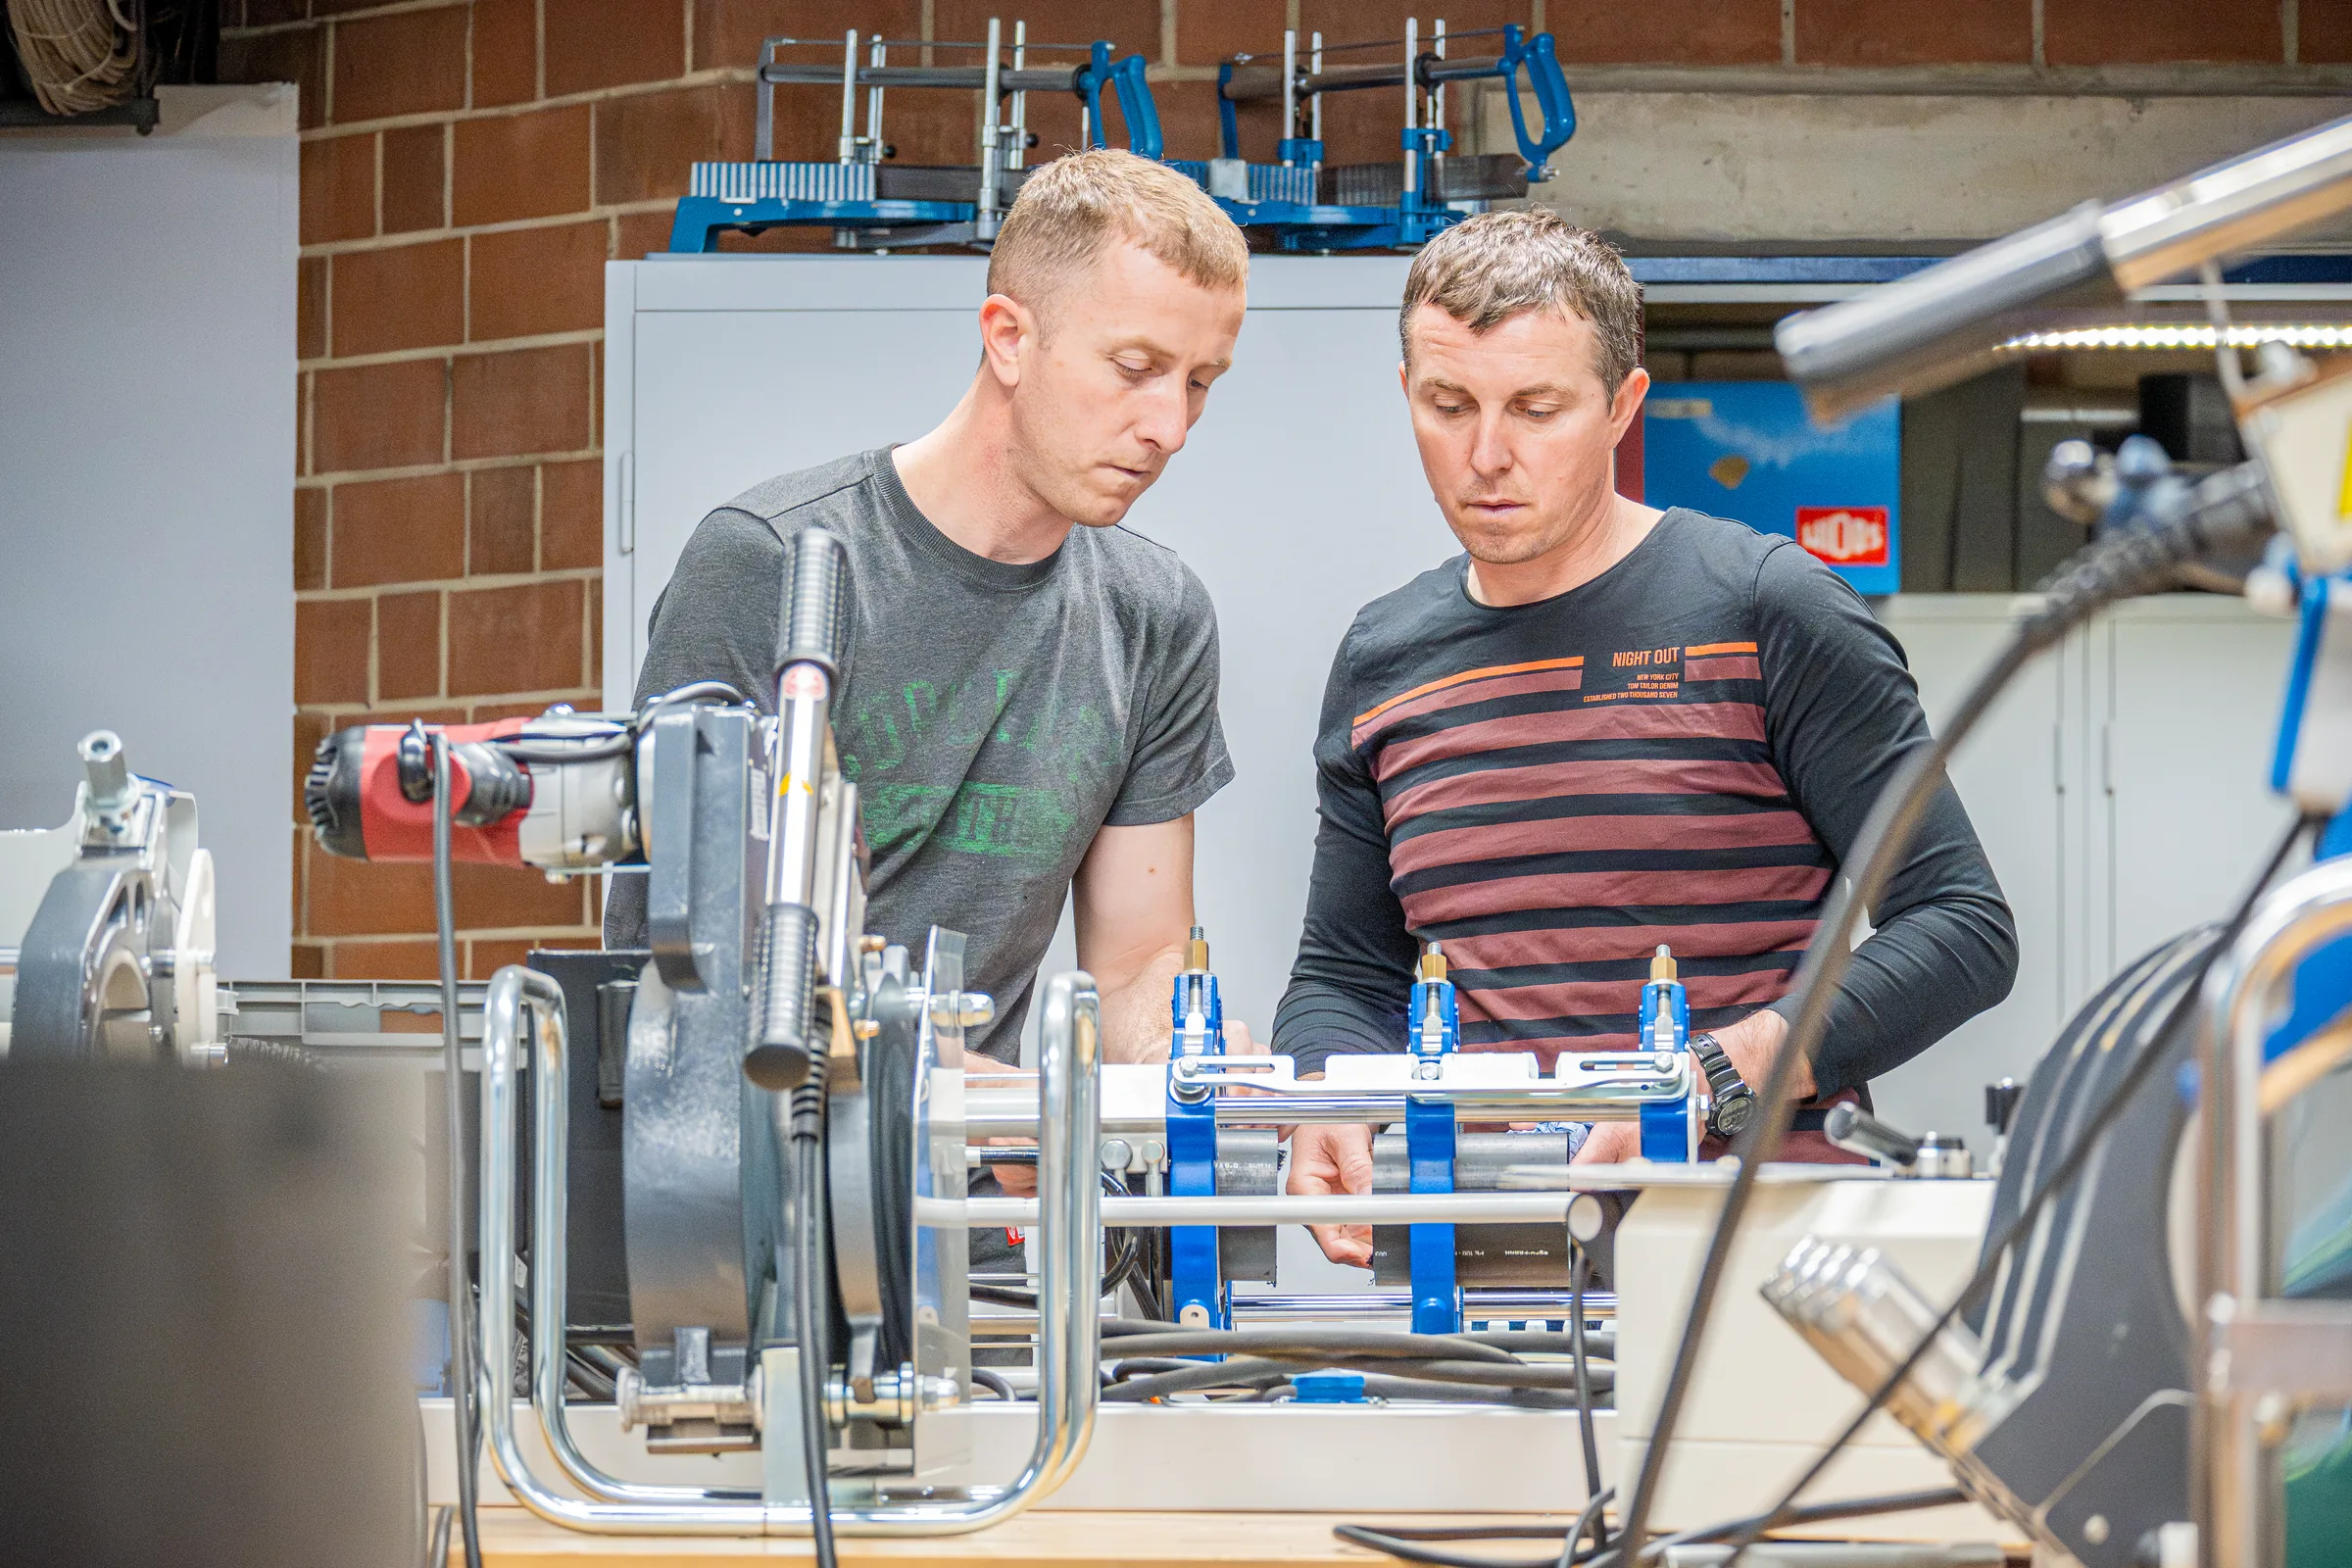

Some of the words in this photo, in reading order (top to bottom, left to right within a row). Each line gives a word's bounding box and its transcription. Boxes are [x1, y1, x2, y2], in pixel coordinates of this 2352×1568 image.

[1612, 651, 1652, 667] NIGHT
[1654, 647, 1681, 664] OUT
[1583, 692, 1617, 703] ESTABLISHED
